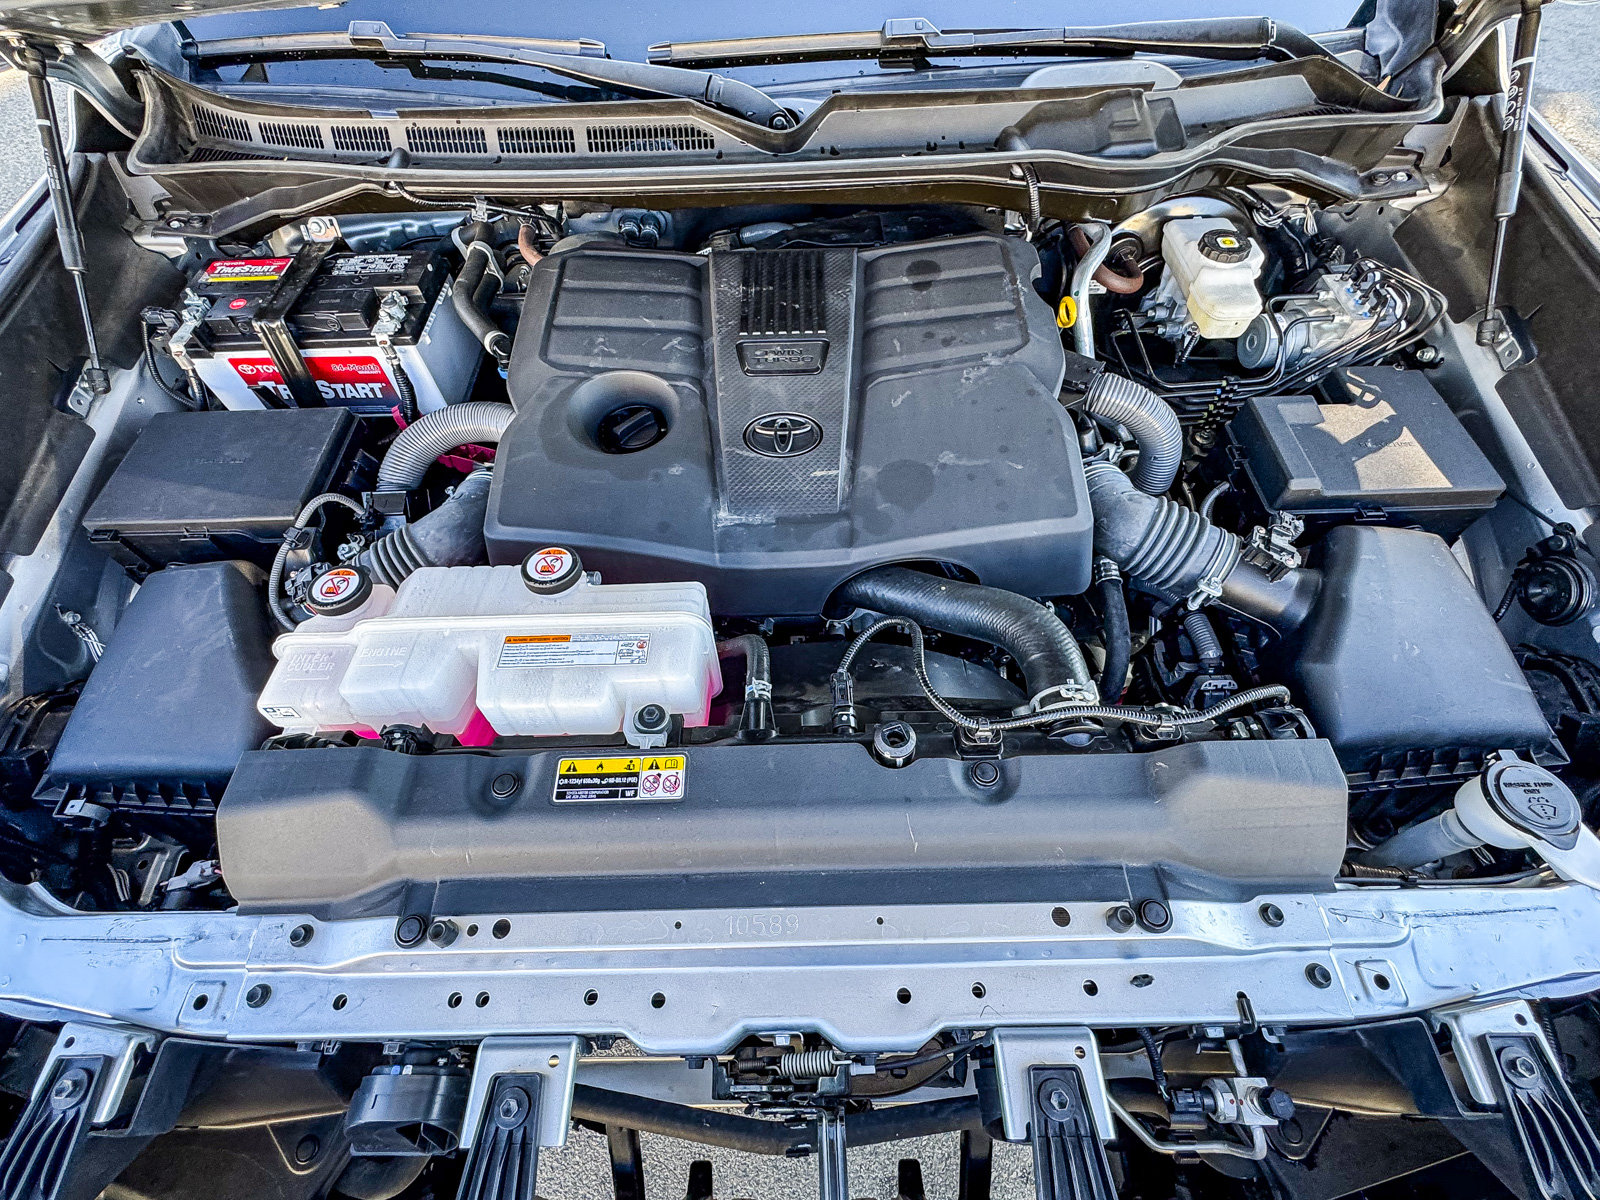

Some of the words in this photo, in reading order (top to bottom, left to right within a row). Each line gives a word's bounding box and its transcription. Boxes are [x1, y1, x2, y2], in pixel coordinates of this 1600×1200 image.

[751, 355, 814, 363] TURBO
[255, 365, 280, 373] TOY
[724, 913, 799, 936] 10589
